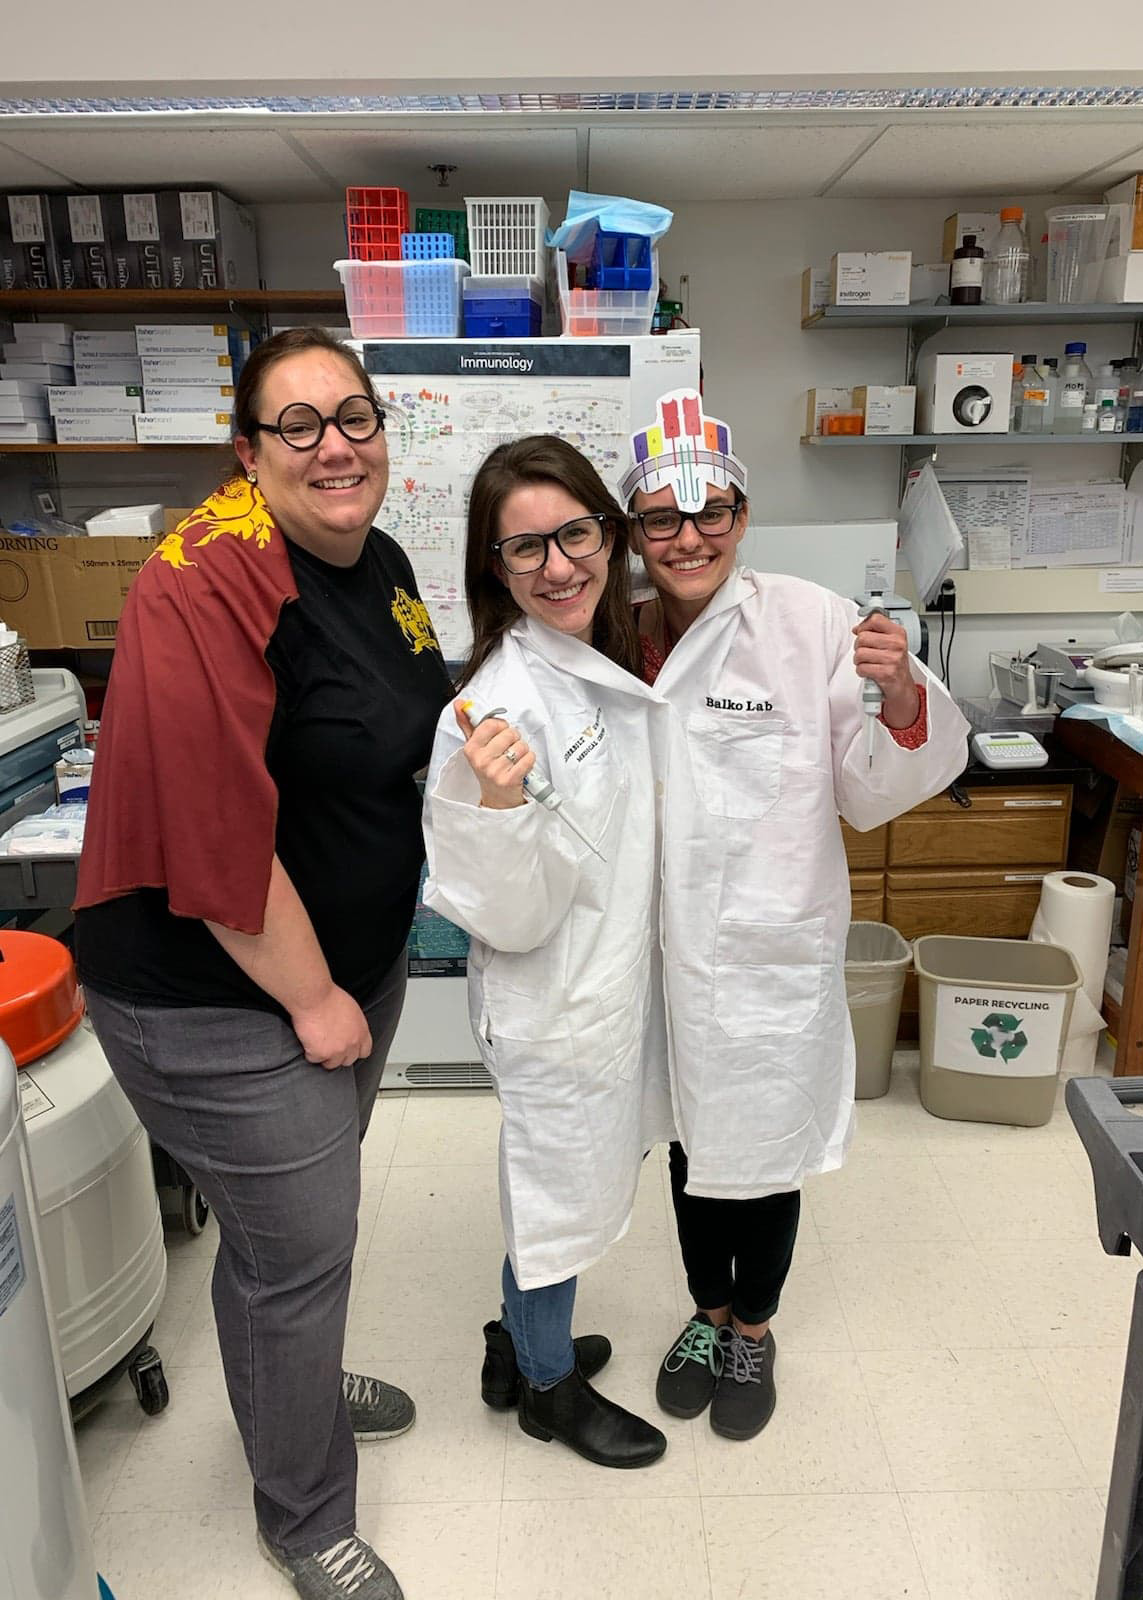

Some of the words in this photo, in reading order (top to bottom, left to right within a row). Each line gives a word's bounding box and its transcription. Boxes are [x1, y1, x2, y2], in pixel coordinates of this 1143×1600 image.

[460, 355, 534, 371] Immunology
[705, 696, 744, 711] Balko
[745, 700, 773, 711] Lab
[954, 996, 989, 1007] PAPER
[991, 999, 1050, 1011] RECYCLING
